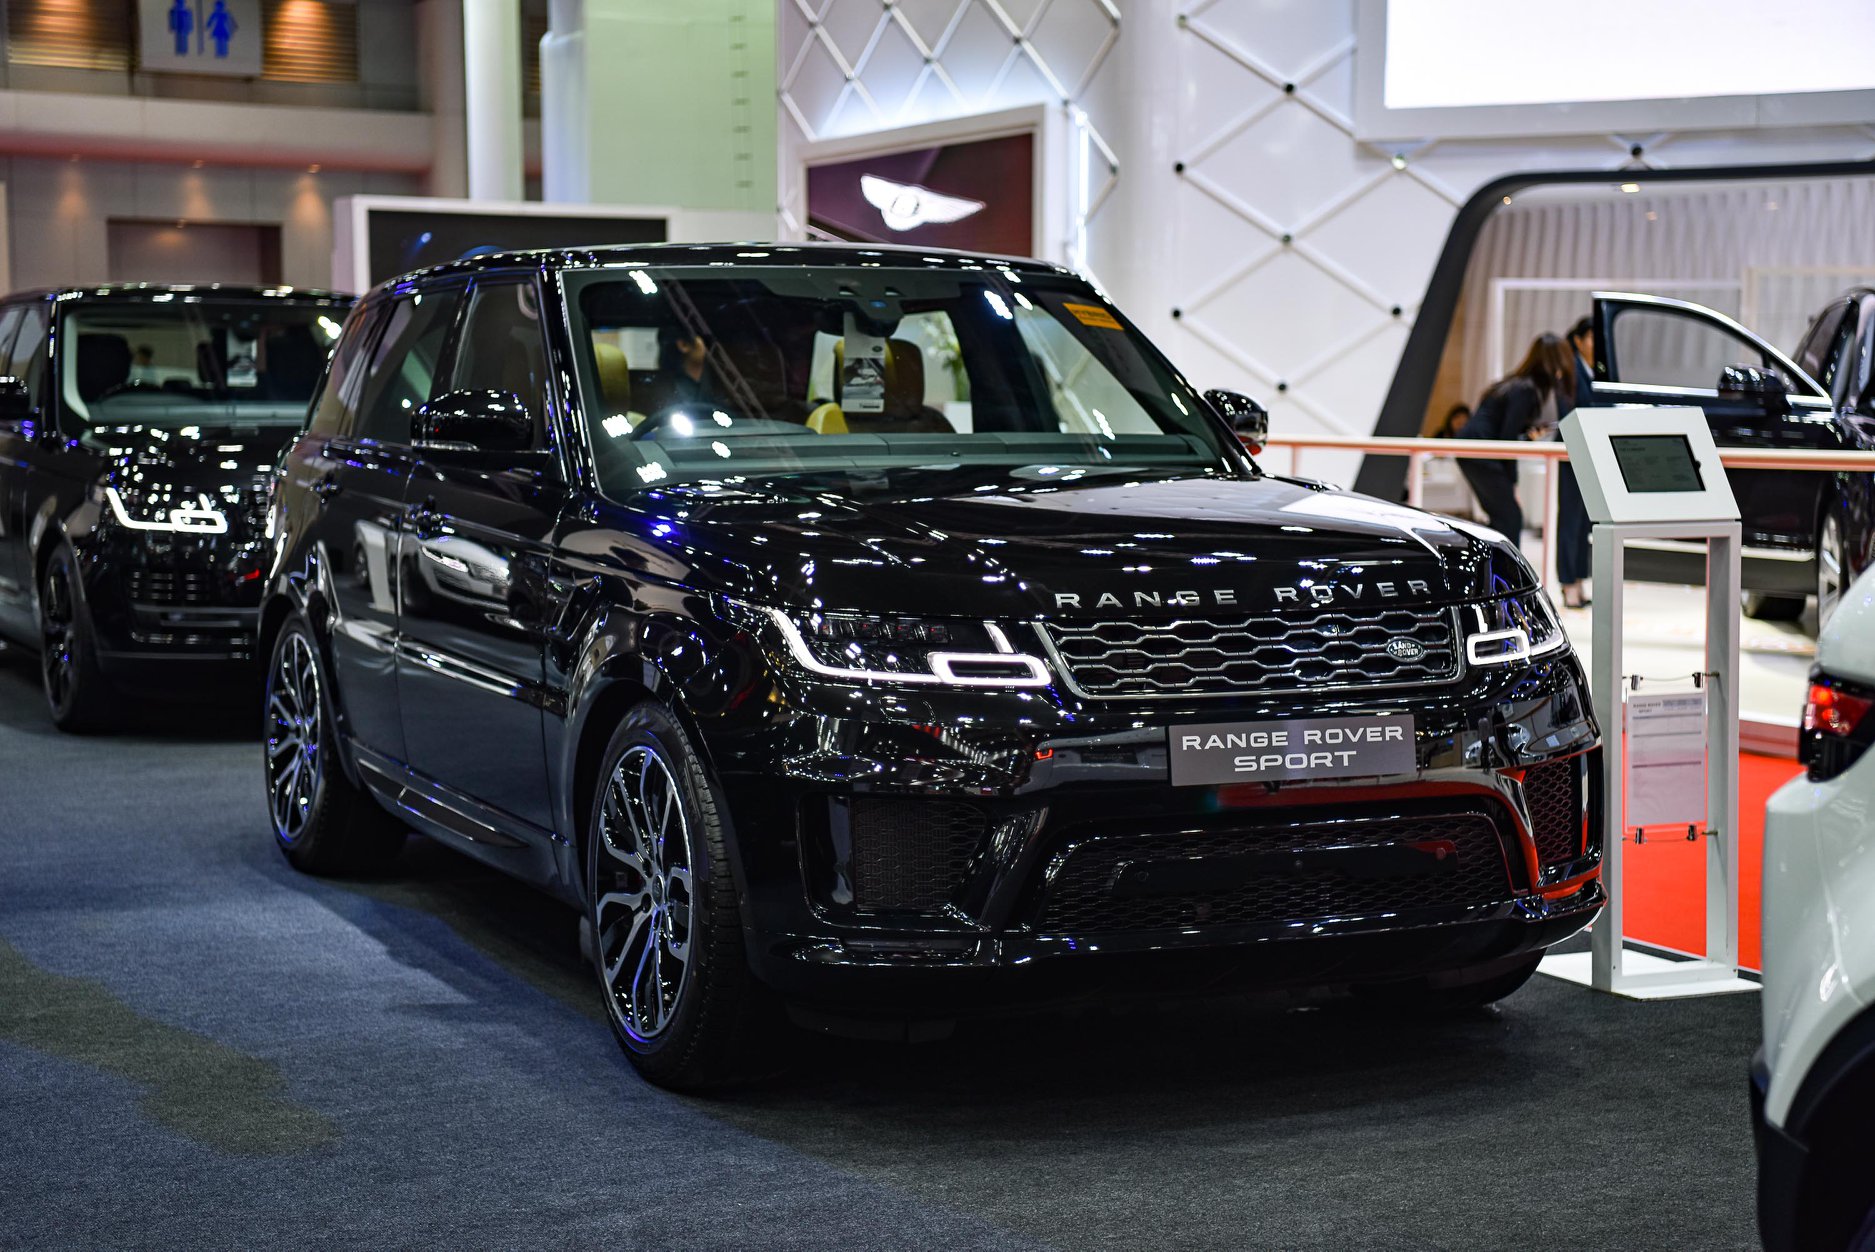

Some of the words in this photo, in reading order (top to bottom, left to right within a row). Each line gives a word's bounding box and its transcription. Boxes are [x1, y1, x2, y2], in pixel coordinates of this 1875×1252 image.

[1055, 589, 1238, 609] RANGE
[1274, 580, 1431, 602] ROVER
[1182, 731, 1288, 750] RANGE
[1303, 726, 1404, 745] ROVER
[1234, 750, 1357, 772] SPORT
